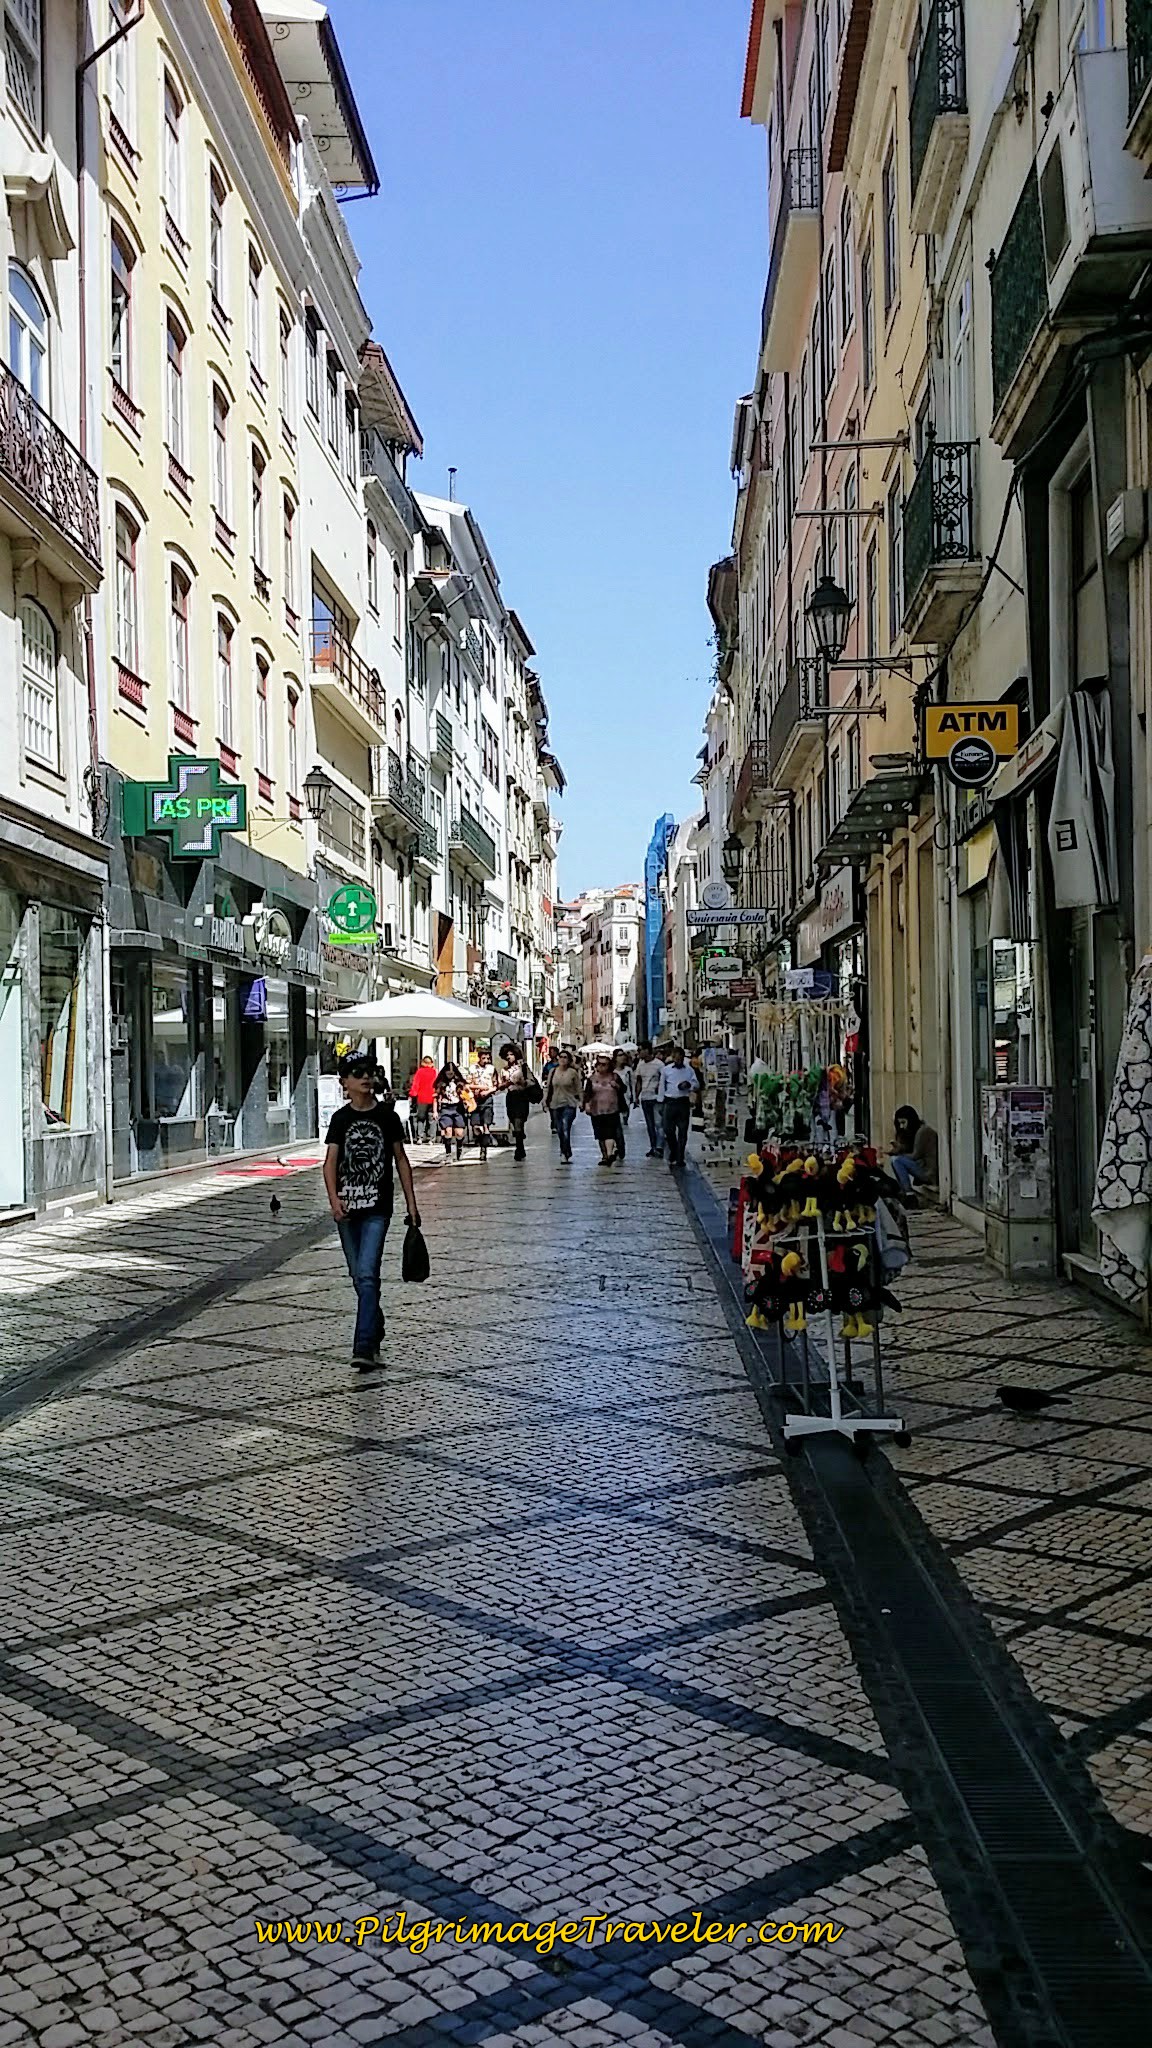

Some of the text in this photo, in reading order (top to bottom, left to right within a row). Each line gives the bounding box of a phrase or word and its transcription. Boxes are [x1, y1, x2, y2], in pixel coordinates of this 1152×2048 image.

[938, 711, 1006, 732] ATM
[160, 797, 191, 818] AS
[740, 909, 764, 922] Costa
[338, 1185, 378, 1197] STAR
